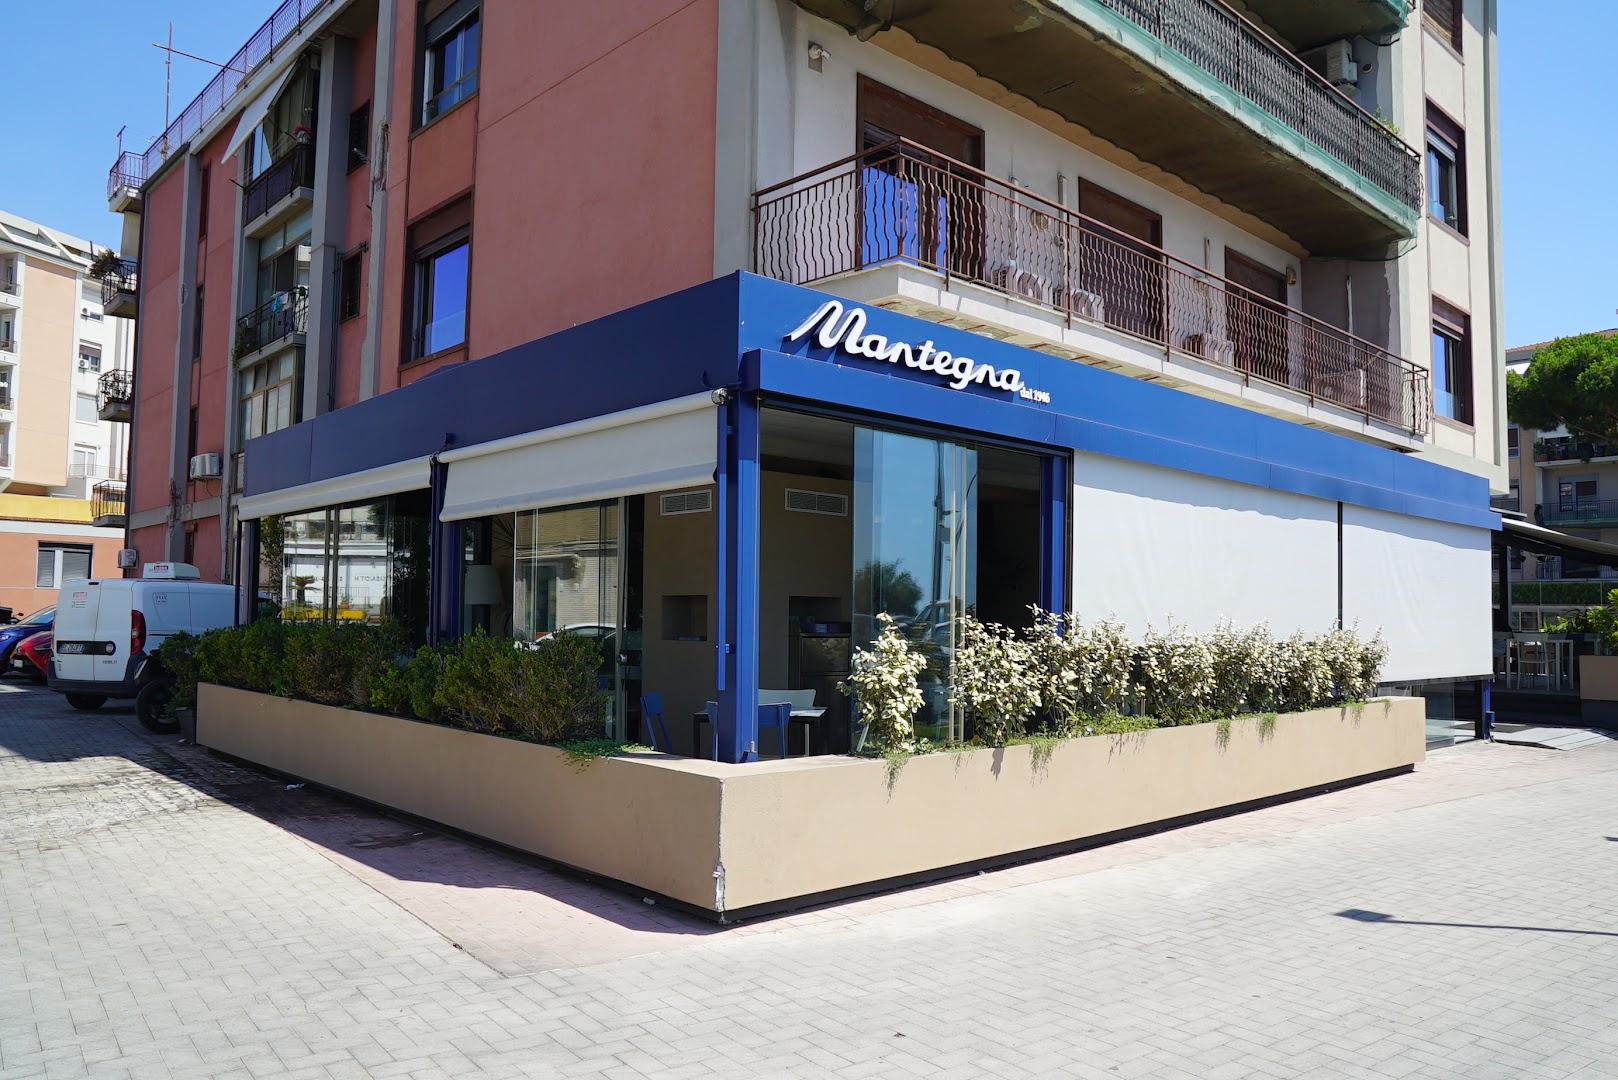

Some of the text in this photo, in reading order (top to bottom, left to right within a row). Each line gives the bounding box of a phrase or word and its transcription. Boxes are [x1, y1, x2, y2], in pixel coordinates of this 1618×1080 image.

[789, 300, 1024, 390] Mantegna
[1019, 386, 1051, 404] dal 1946
